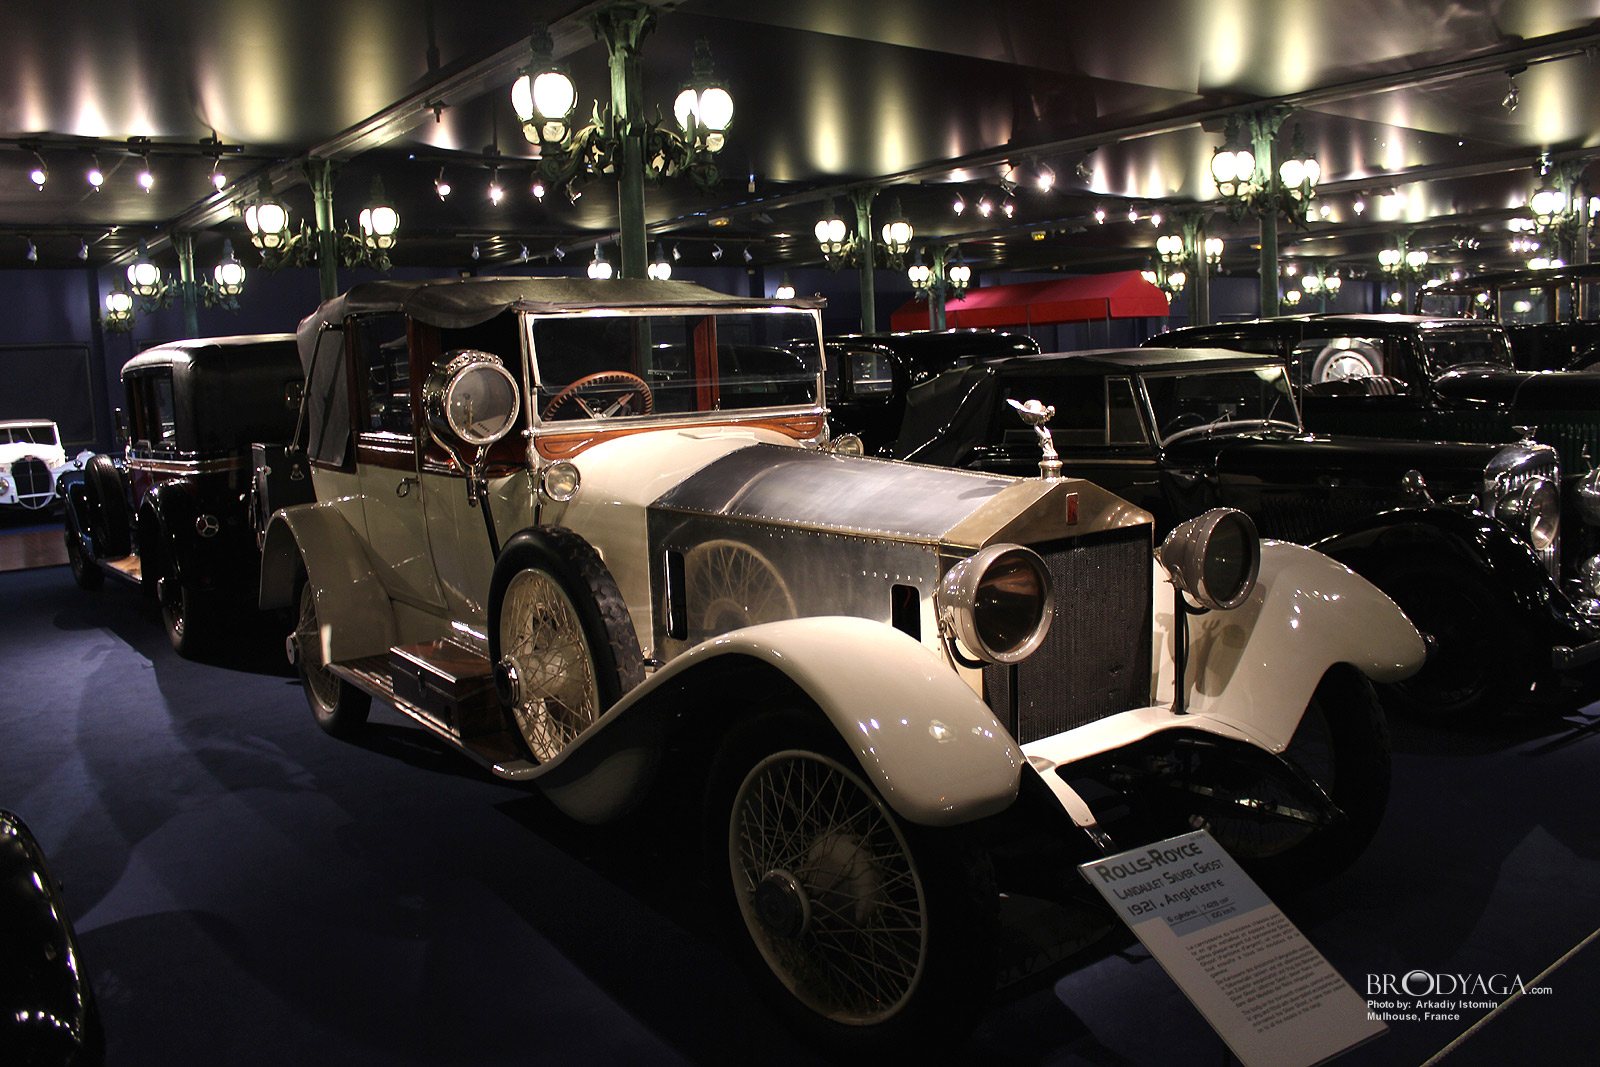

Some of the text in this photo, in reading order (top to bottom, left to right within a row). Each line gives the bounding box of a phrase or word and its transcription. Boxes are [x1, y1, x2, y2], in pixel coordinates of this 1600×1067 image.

[1094, 842, 1203, 884] ROLLS-ROYCE
[1162, 869, 1194, 886] SILVER
[1193, 859, 1224, 875] GHOST
[1127, 897, 1157, 917] 1921
[1164, 878, 1225, 906] Angleterre
